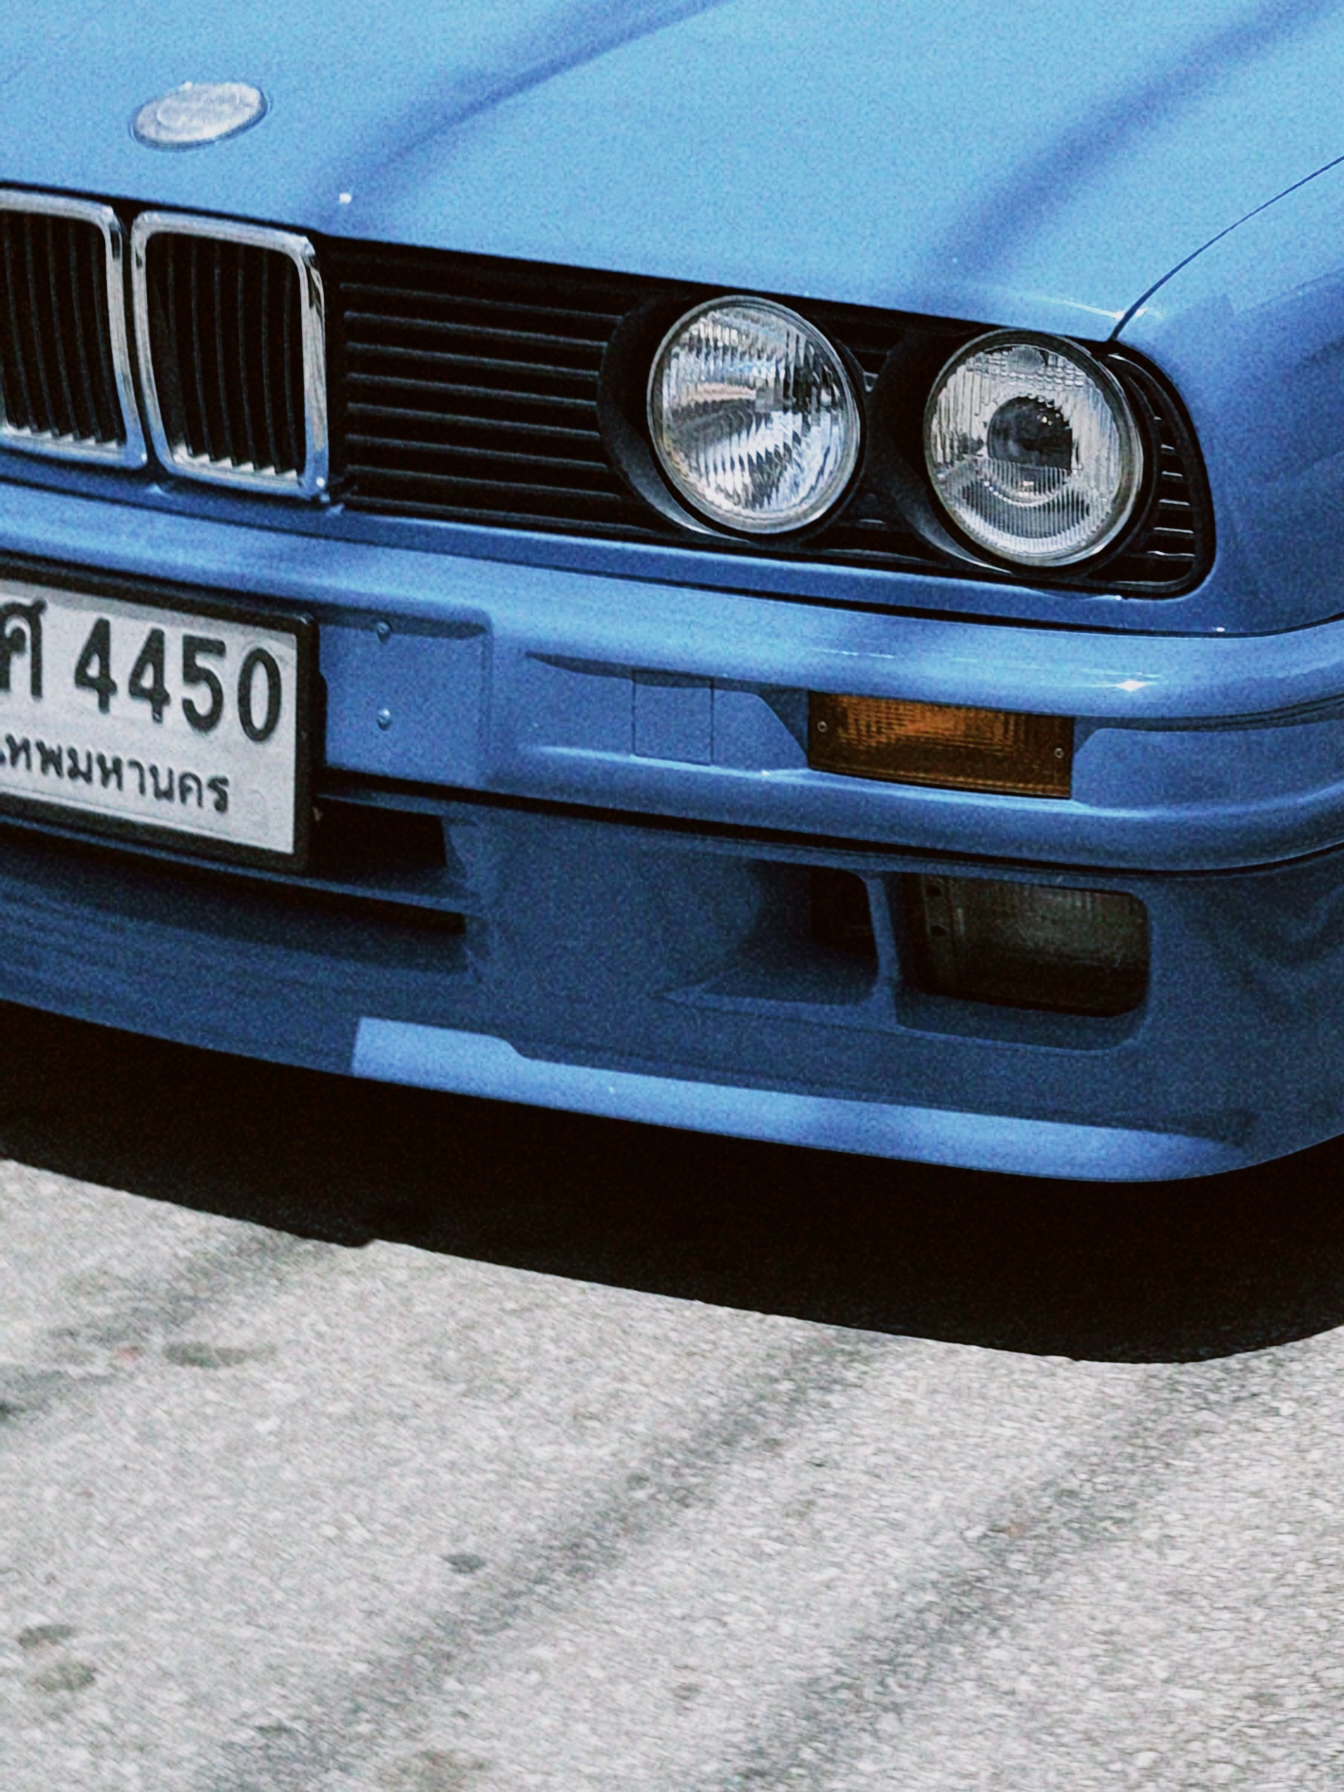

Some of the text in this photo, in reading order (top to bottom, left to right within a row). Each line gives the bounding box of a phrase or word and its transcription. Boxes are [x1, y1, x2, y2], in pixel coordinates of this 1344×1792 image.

[73, 616, 284, 743] 4450
[0, 732, 230, 814] ทพมหานคร
